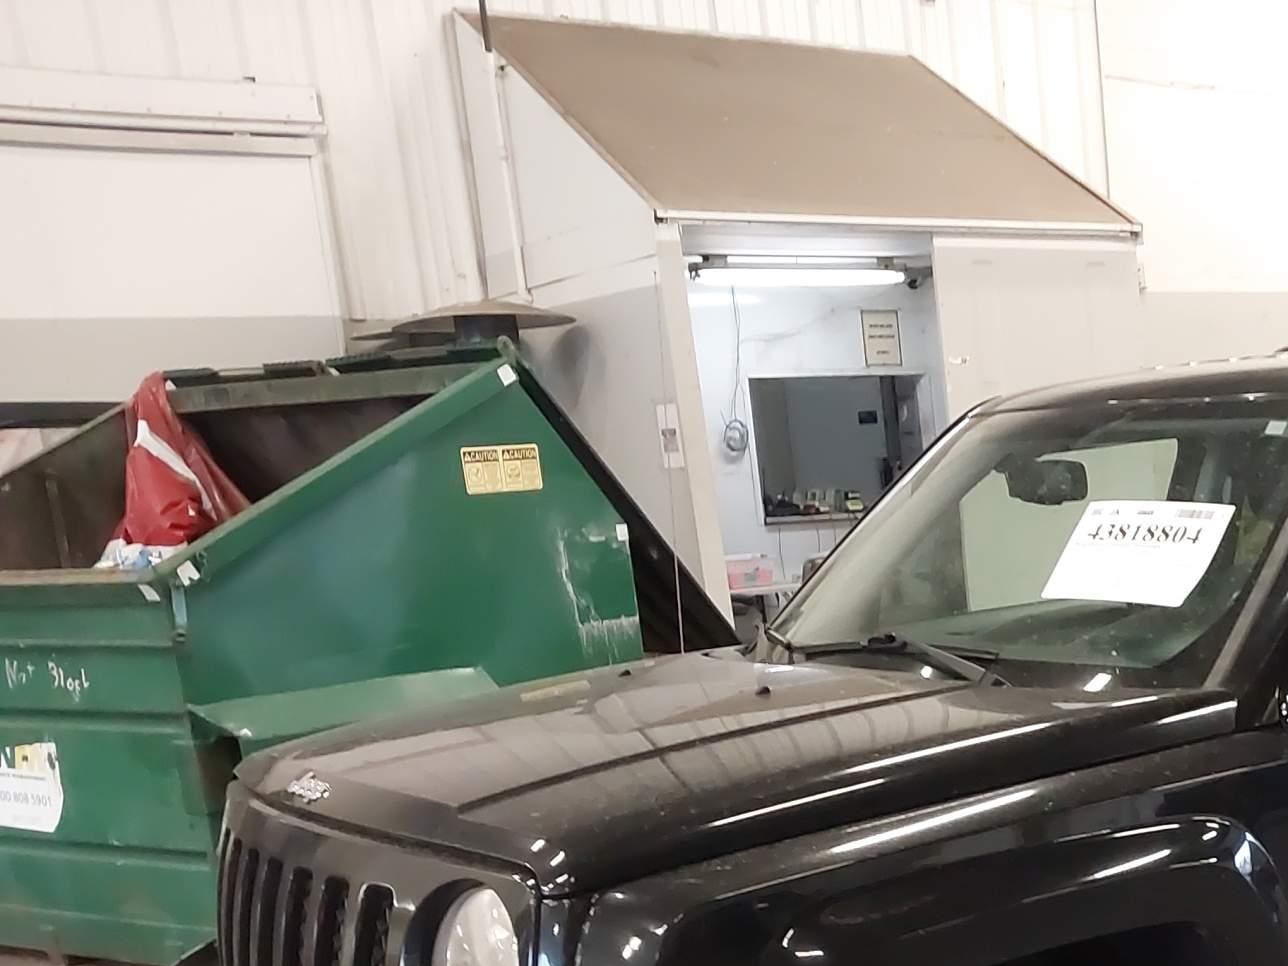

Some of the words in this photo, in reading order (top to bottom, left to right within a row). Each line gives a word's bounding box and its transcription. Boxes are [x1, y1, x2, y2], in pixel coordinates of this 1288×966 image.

[470, 449, 499, 462] CAUTION
[509, 447, 537, 460] CAUTION
[1088, 523, 1203, 544] 43818804
